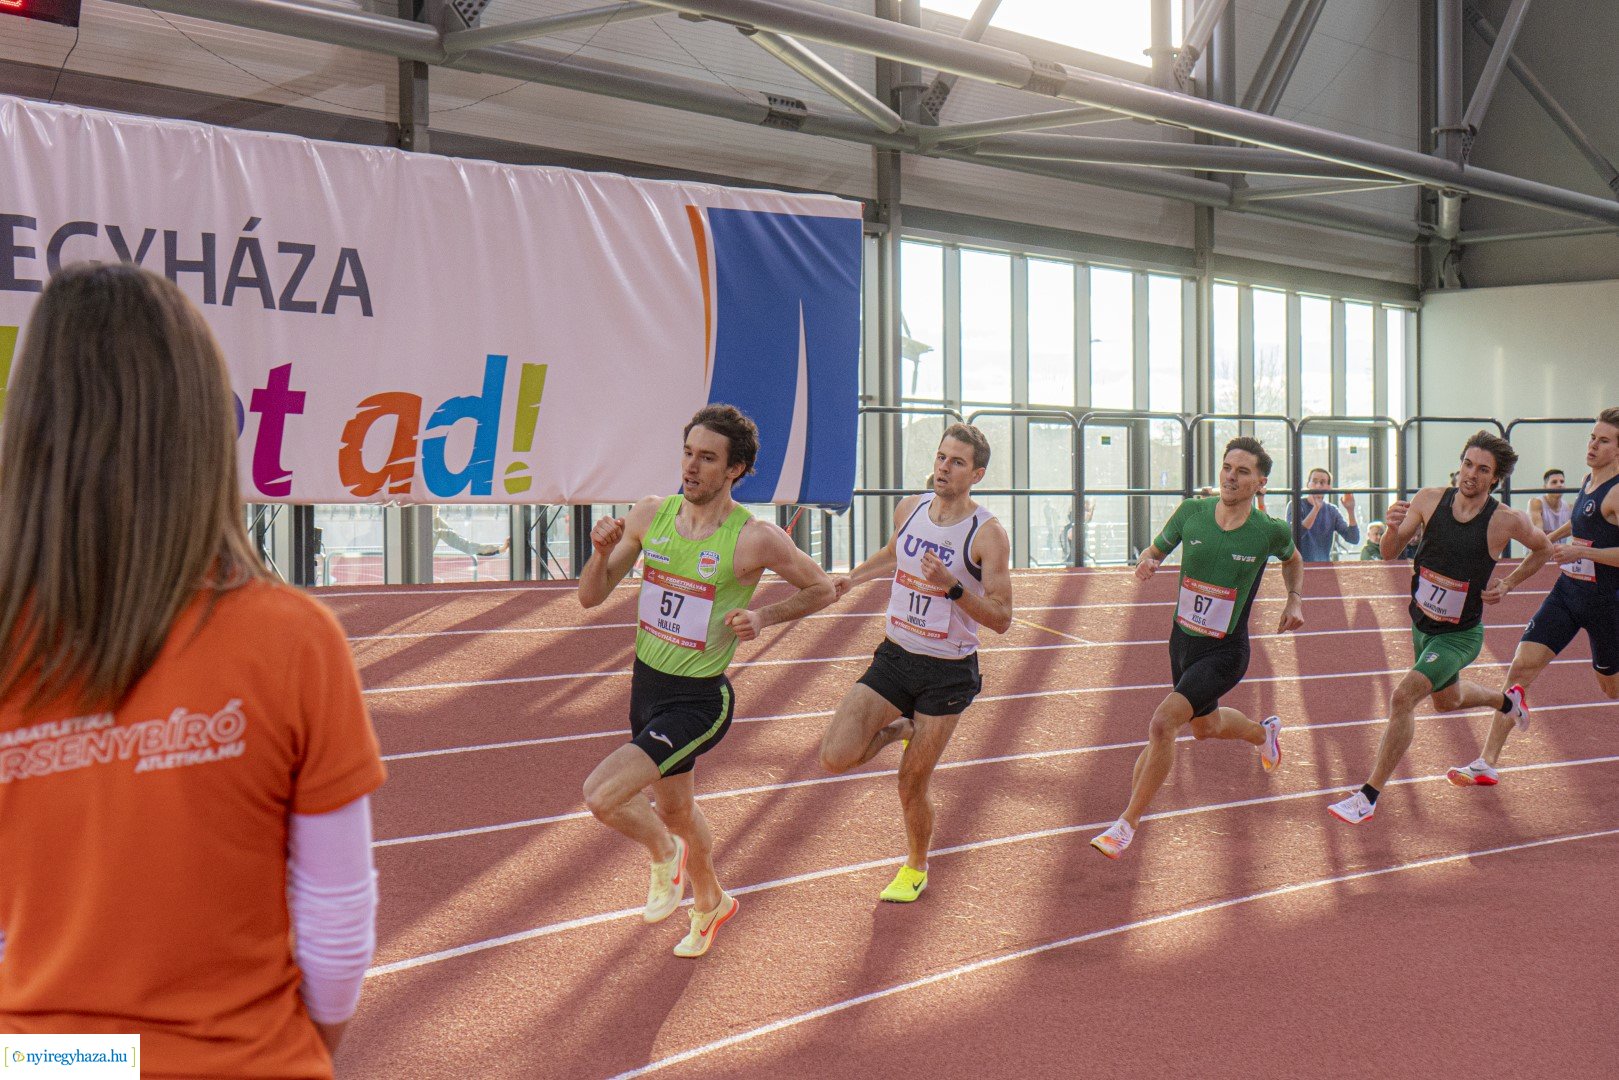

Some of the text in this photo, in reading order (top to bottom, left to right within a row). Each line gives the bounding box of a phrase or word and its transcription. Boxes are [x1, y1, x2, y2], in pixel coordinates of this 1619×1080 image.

[338, 354, 548, 498] ad!
[903, 534, 955, 568] UTE
[660, 590, 685, 619] 57
[909, 591, 932, 617] 117
[1194, 594, 1213, 616] 67
[1430, 584, 1447, 605] 77
[657, 618, 681, 634] HULLER
